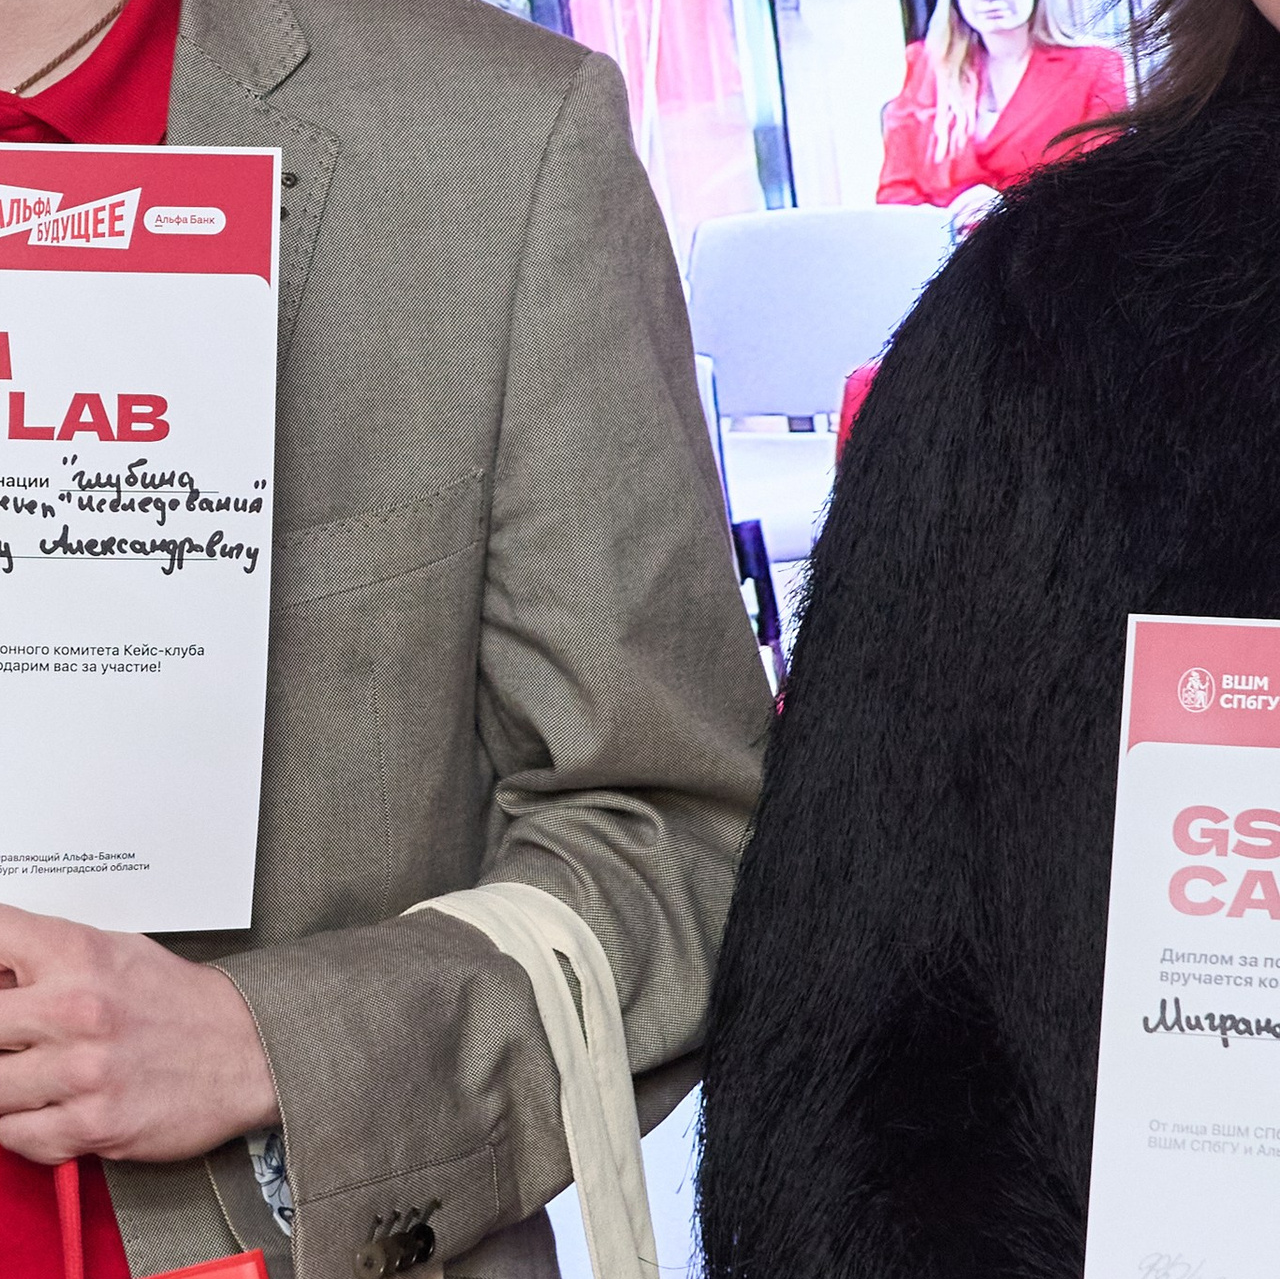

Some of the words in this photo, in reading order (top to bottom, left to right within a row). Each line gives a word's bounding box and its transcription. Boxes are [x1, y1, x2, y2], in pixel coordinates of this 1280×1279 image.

[37, 200, 126, 244] БУДУЩЕЕ
[154, 213, 189, 228] Альфа
[190, 214, 215, 225] Банк
[7, 390, 171, 443] LAB
[54, 645, 120, 656] комитета
[123, 643, 205, 659] Кейс-клуба
[54, 662, 78, 673] вас
[82, 662, 97, 673] за
[101, 661, 162, 675] участие!
[1222, 674, 1269, 691] ВШМ
[1219, 693, 1280, 711] СПбГУ
[62, 851, 136, 862] Альфа-Банком
[21, 866, 28, 874] и
[30, 863, 108, 875] Ленинградской
[109, 862, 150, 872] области
[1160, 948, 1234, 966] Диплом
[1238, 954, 1259, 968] за
[1159, 970, 1253, 987] вручается
